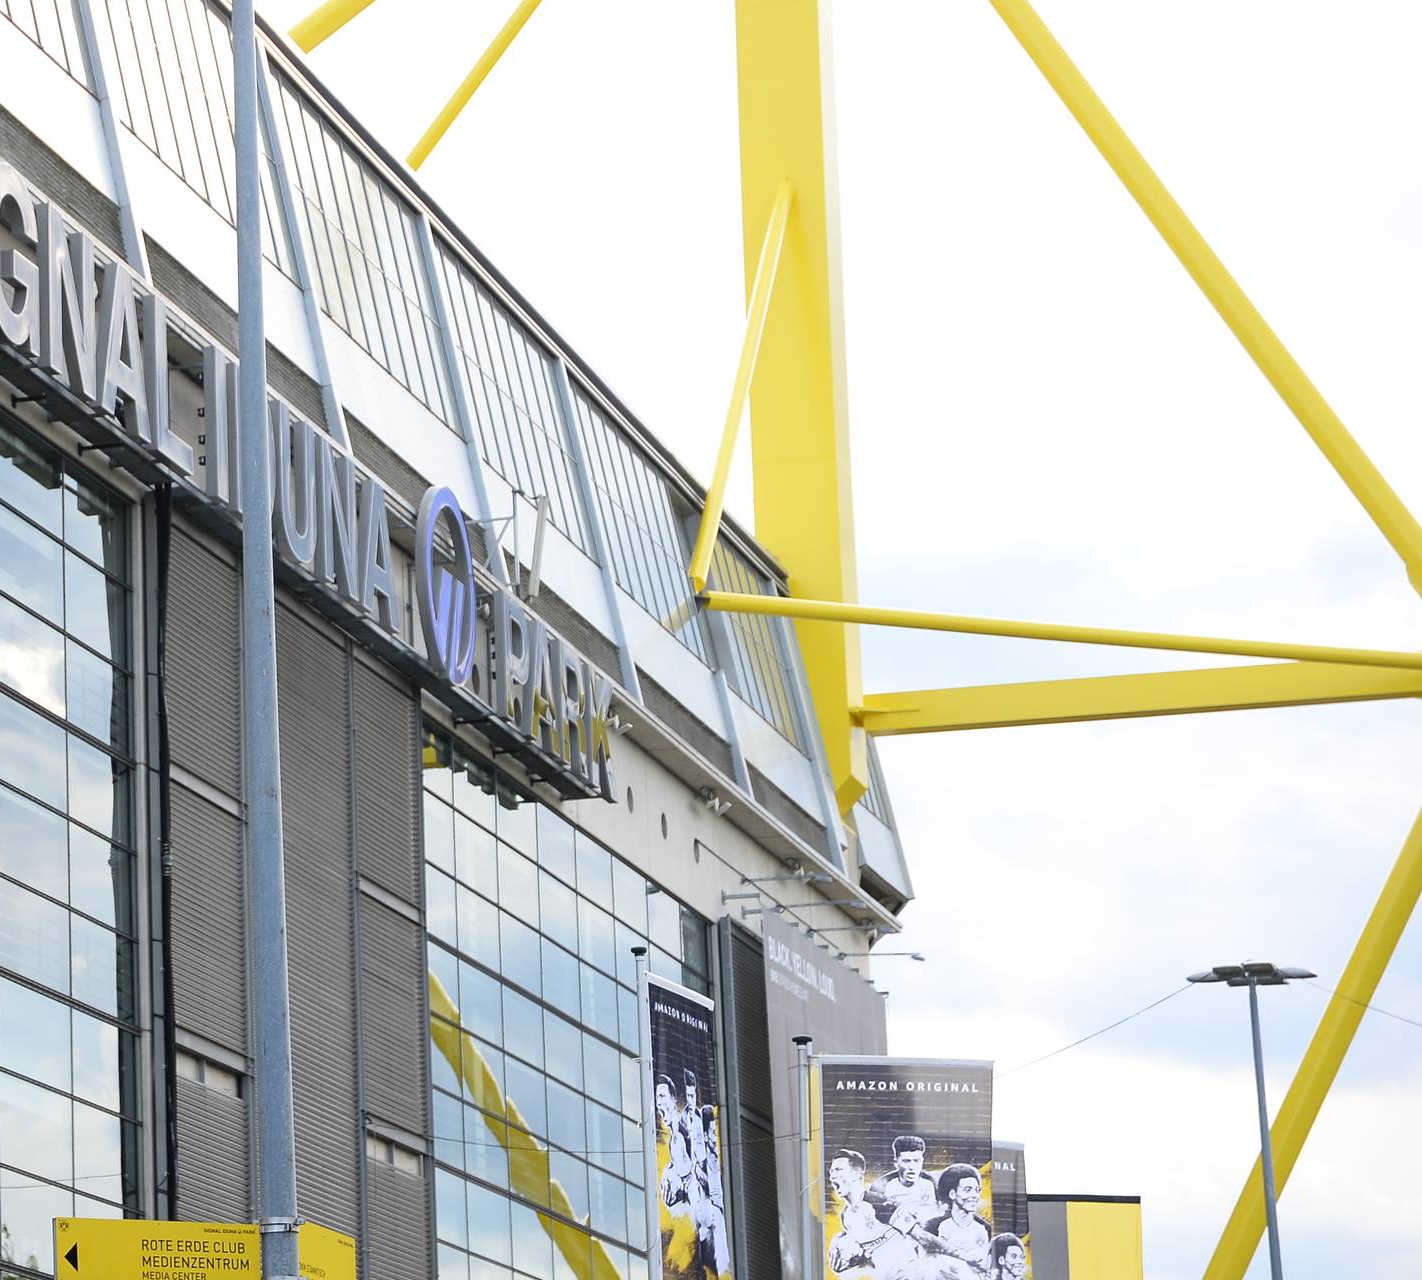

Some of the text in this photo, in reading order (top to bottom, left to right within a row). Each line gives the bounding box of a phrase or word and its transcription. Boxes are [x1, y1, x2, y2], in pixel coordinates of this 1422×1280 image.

[203, 346, 400, 635] IUNA
[493, 590, 618, 804] PARK
[654, 1002, 680, 1020] AMAZON
[836, 1080, 979, 1093] AMAZON ORIGINAL
[995, 1161, 1016, 1171] NAL
[142, 1239, 245, 1254] ROTE ERDE CLUB
[142, 1256, 250, 1270] MEDIENZENTRUM
[142, 1272, 207, 1280] MEDIA CENTER
